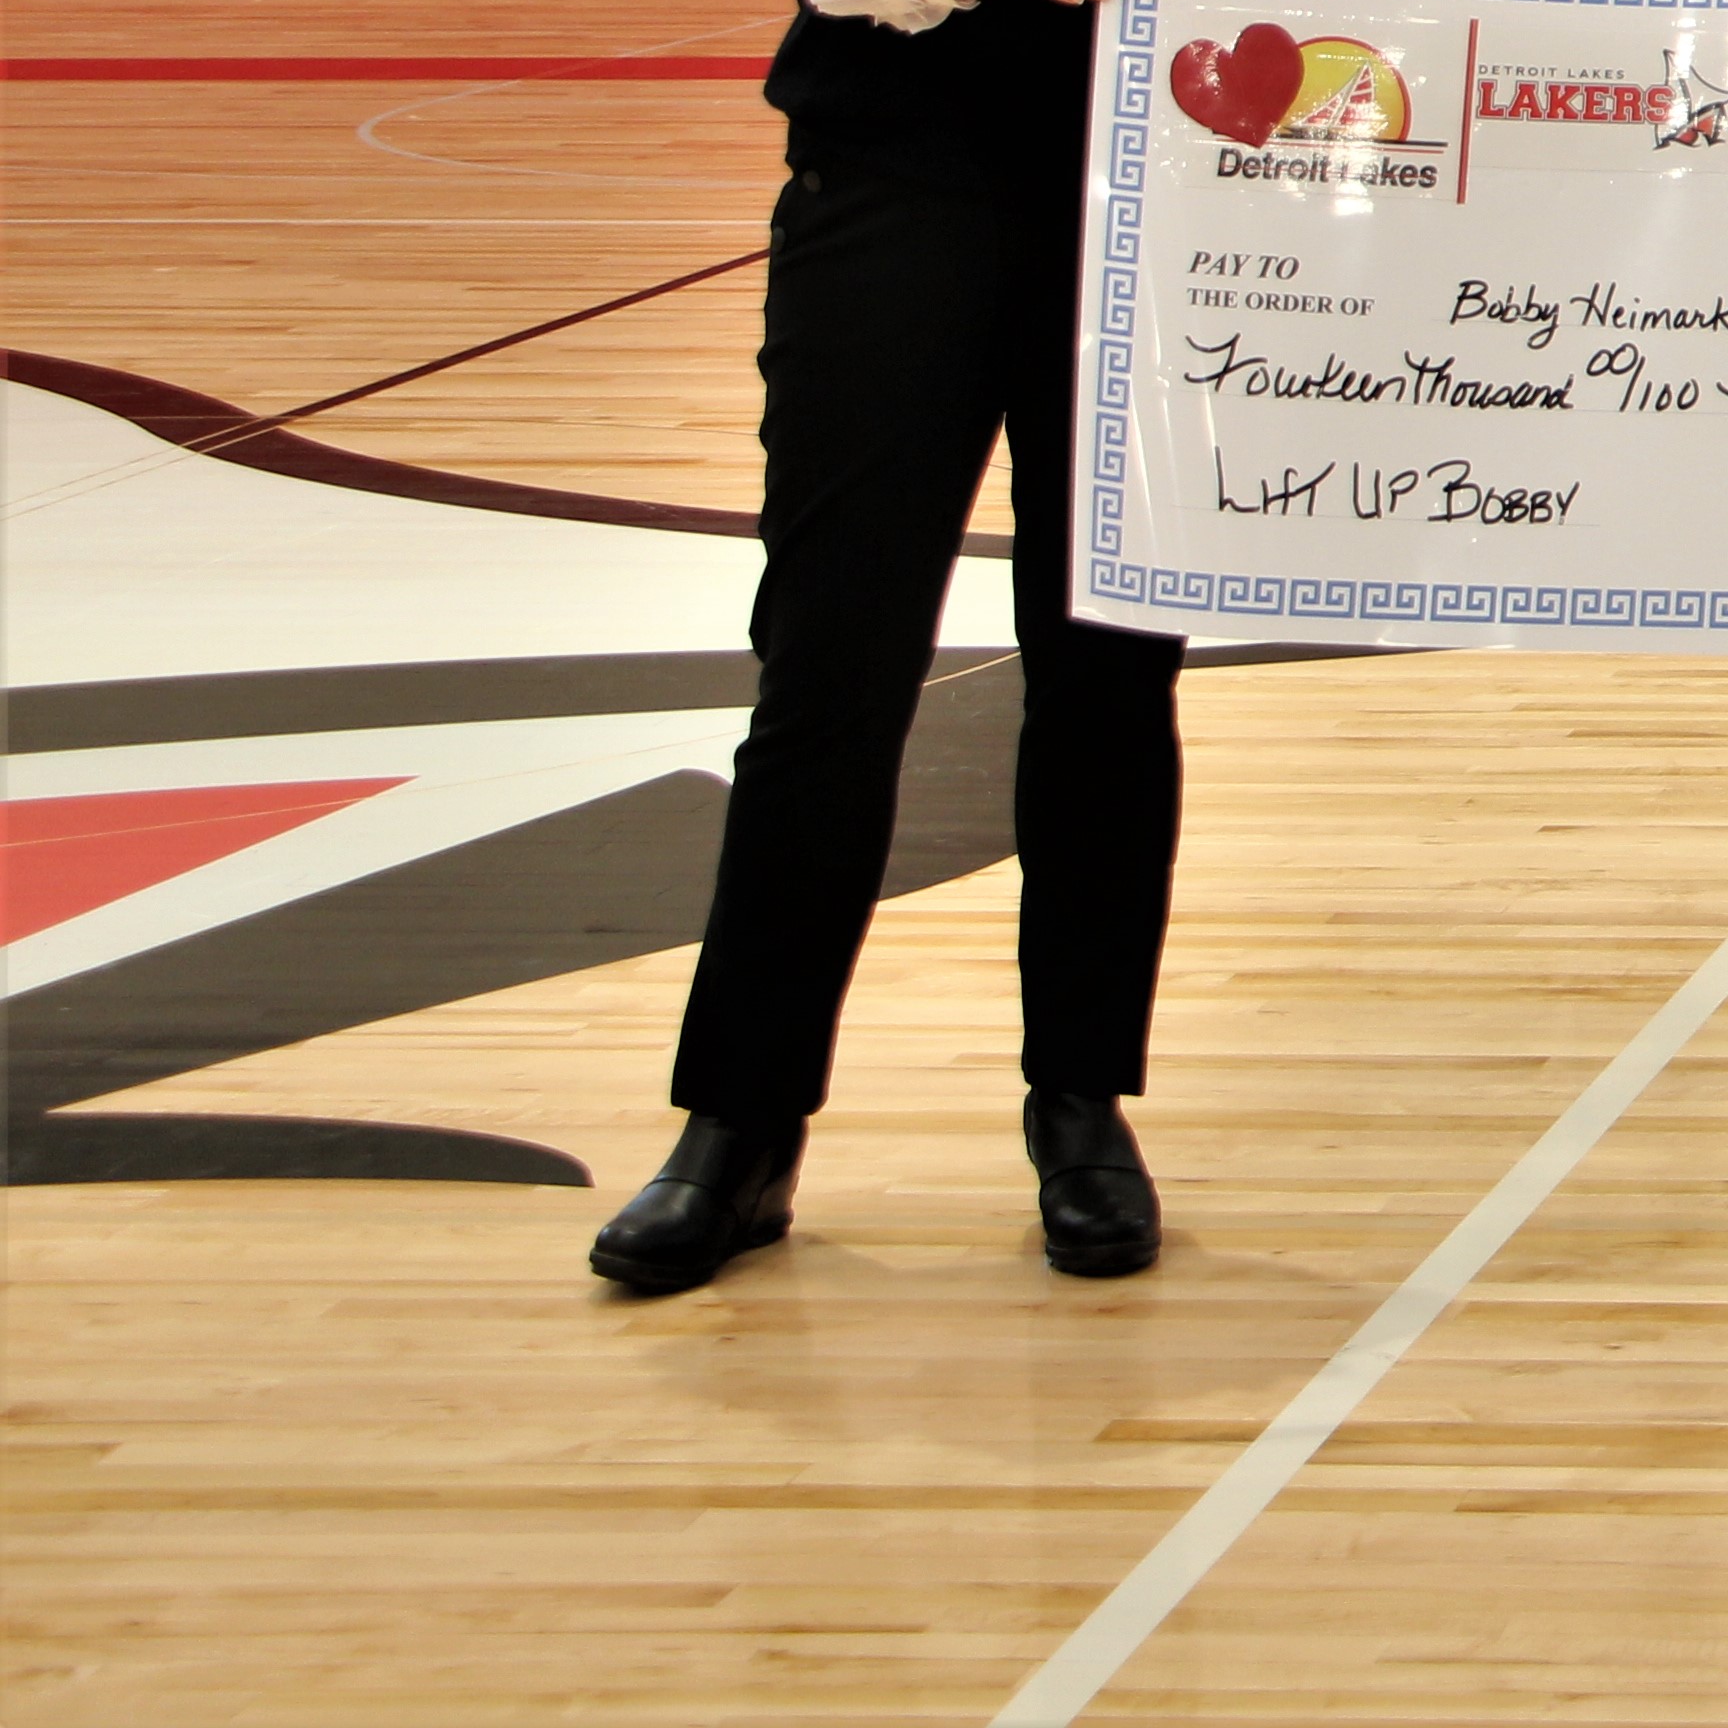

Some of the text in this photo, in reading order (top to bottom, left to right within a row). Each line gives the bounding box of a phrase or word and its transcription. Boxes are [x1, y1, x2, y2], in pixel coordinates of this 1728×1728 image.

[1478, 63, 1625, 81] DETROIT LAKES
[1476, 79, 1676, 125] LAKERS
[1216, 146, 1330, 184] Detroit
[1188, 251, 1301, 280] PAY TO
[1187, 287, 1375, 318] THE ORDER OF
[1449, 280, 1560, 349] Bobby
[1353, 462, 1419, 520] UP
